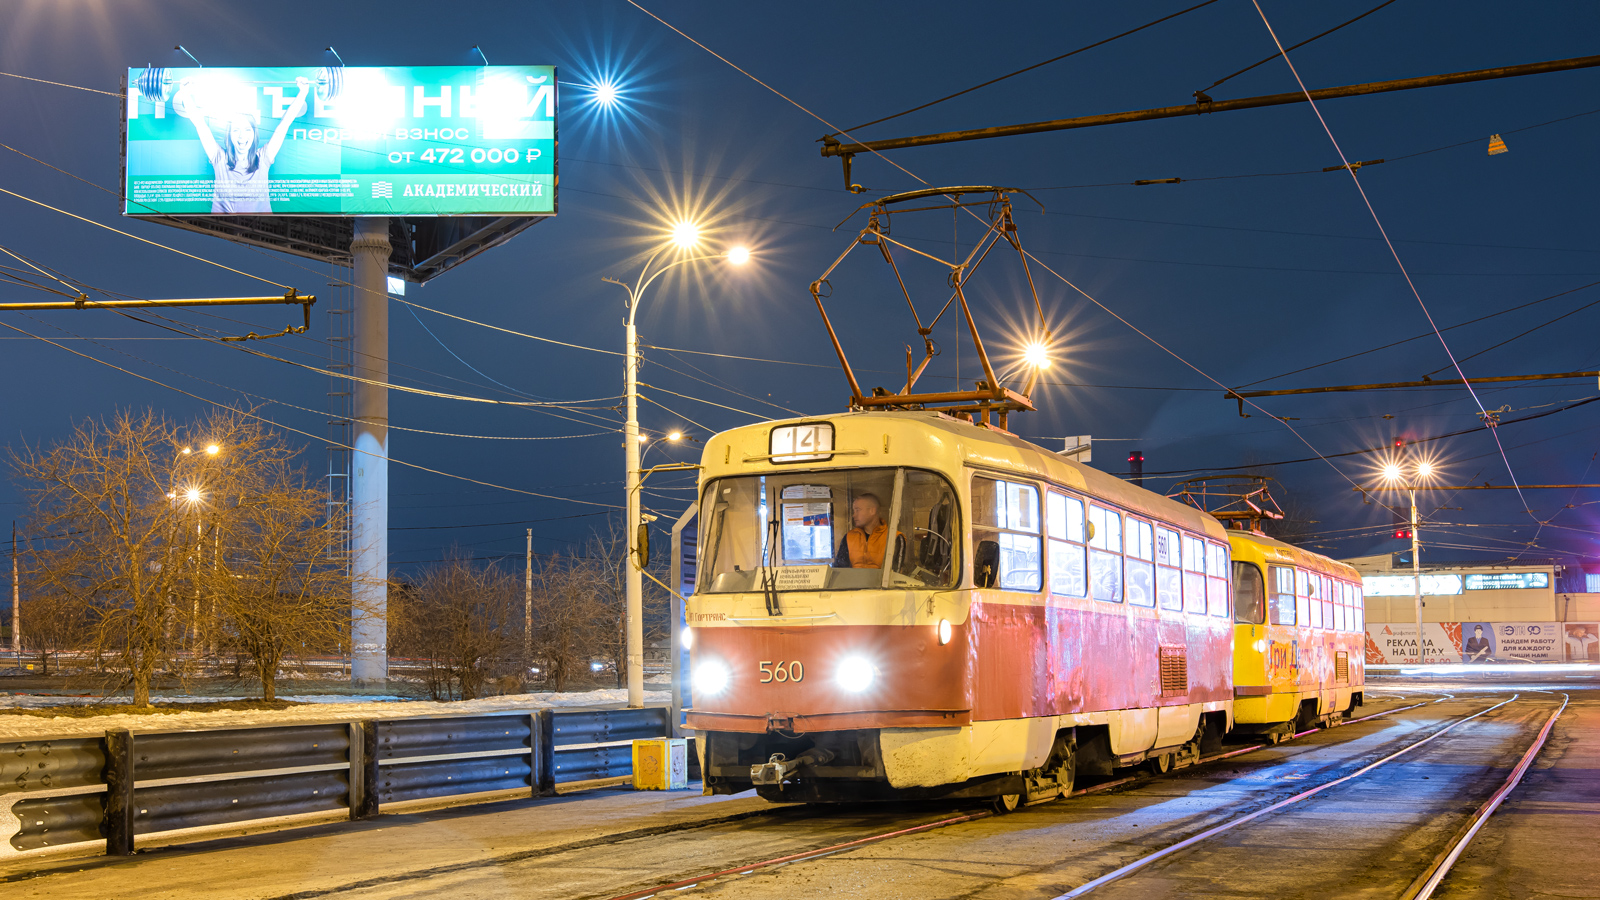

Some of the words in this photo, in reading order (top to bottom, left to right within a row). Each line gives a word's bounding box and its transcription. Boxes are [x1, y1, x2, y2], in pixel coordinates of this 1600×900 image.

[395, 128, 469, 140] взнос
[388, 152, 415, 163] от
[420, 148, 464, 163] 472
[471, 148, 519, 163] 000
[403, 181, 543, 198] АКАДЕМИЧЕСКИЙ
[787, 426, 821, 458] 14
[1158, 535, 1167, 555] 560
[1269, 640, 1287, 675] Три
[1392, 648, 1406, 656] НА
[759, 660, 804, 683] 560
